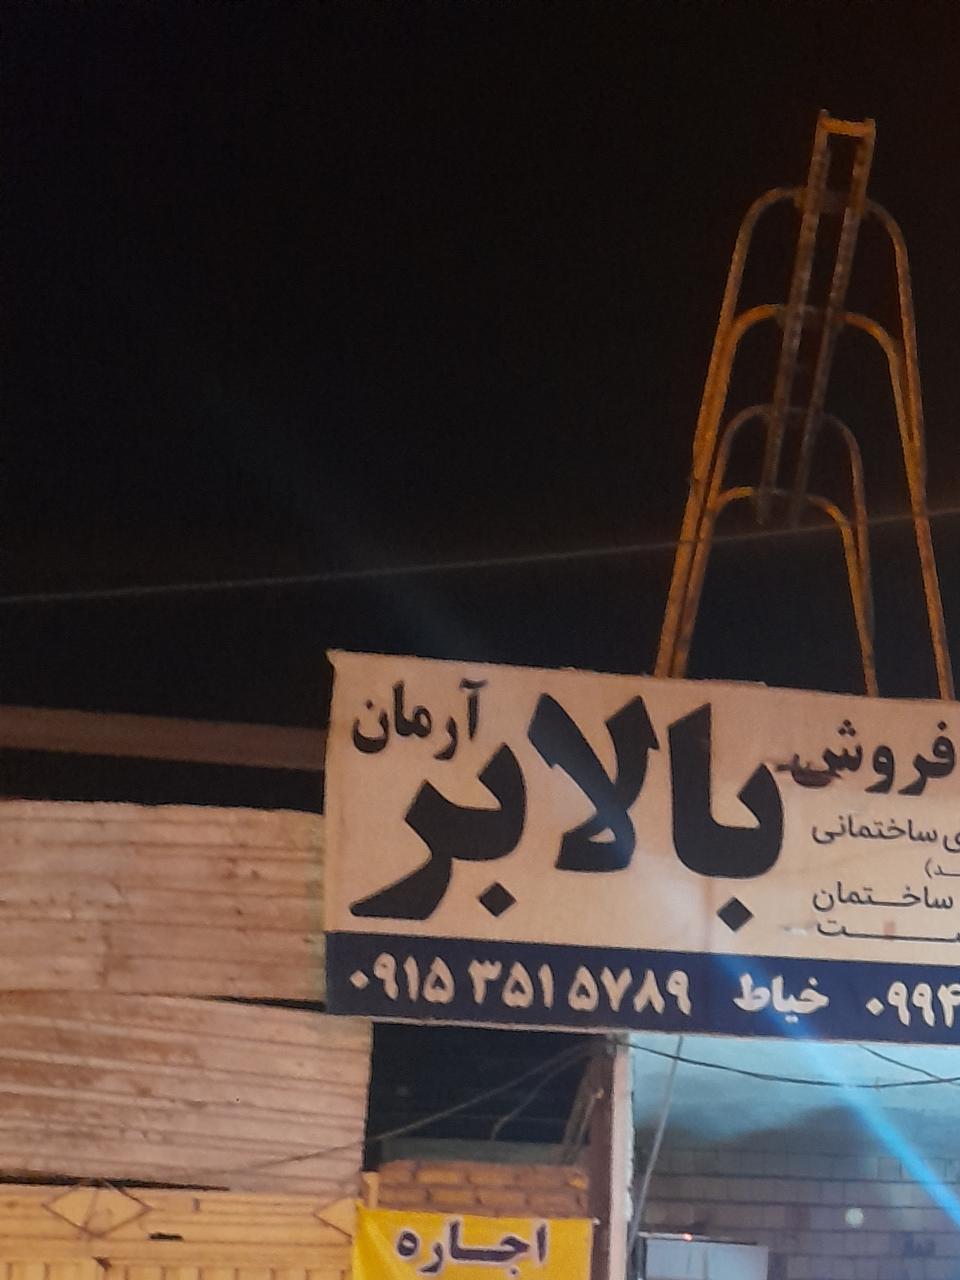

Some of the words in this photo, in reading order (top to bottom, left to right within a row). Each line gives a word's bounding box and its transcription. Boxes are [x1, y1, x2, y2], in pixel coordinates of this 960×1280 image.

[352, 678, 487, 760] آرمان
[775, 719, 956, 796] فروش
[350, 693, 785, 932] بالابر
[811, 814, 938, 845] ساختمانی
[812, 880, 953, 912] ساختمان
[732, 973, 830, 1024] خیاط
[397, 1218, 548, 1277] اجاره
